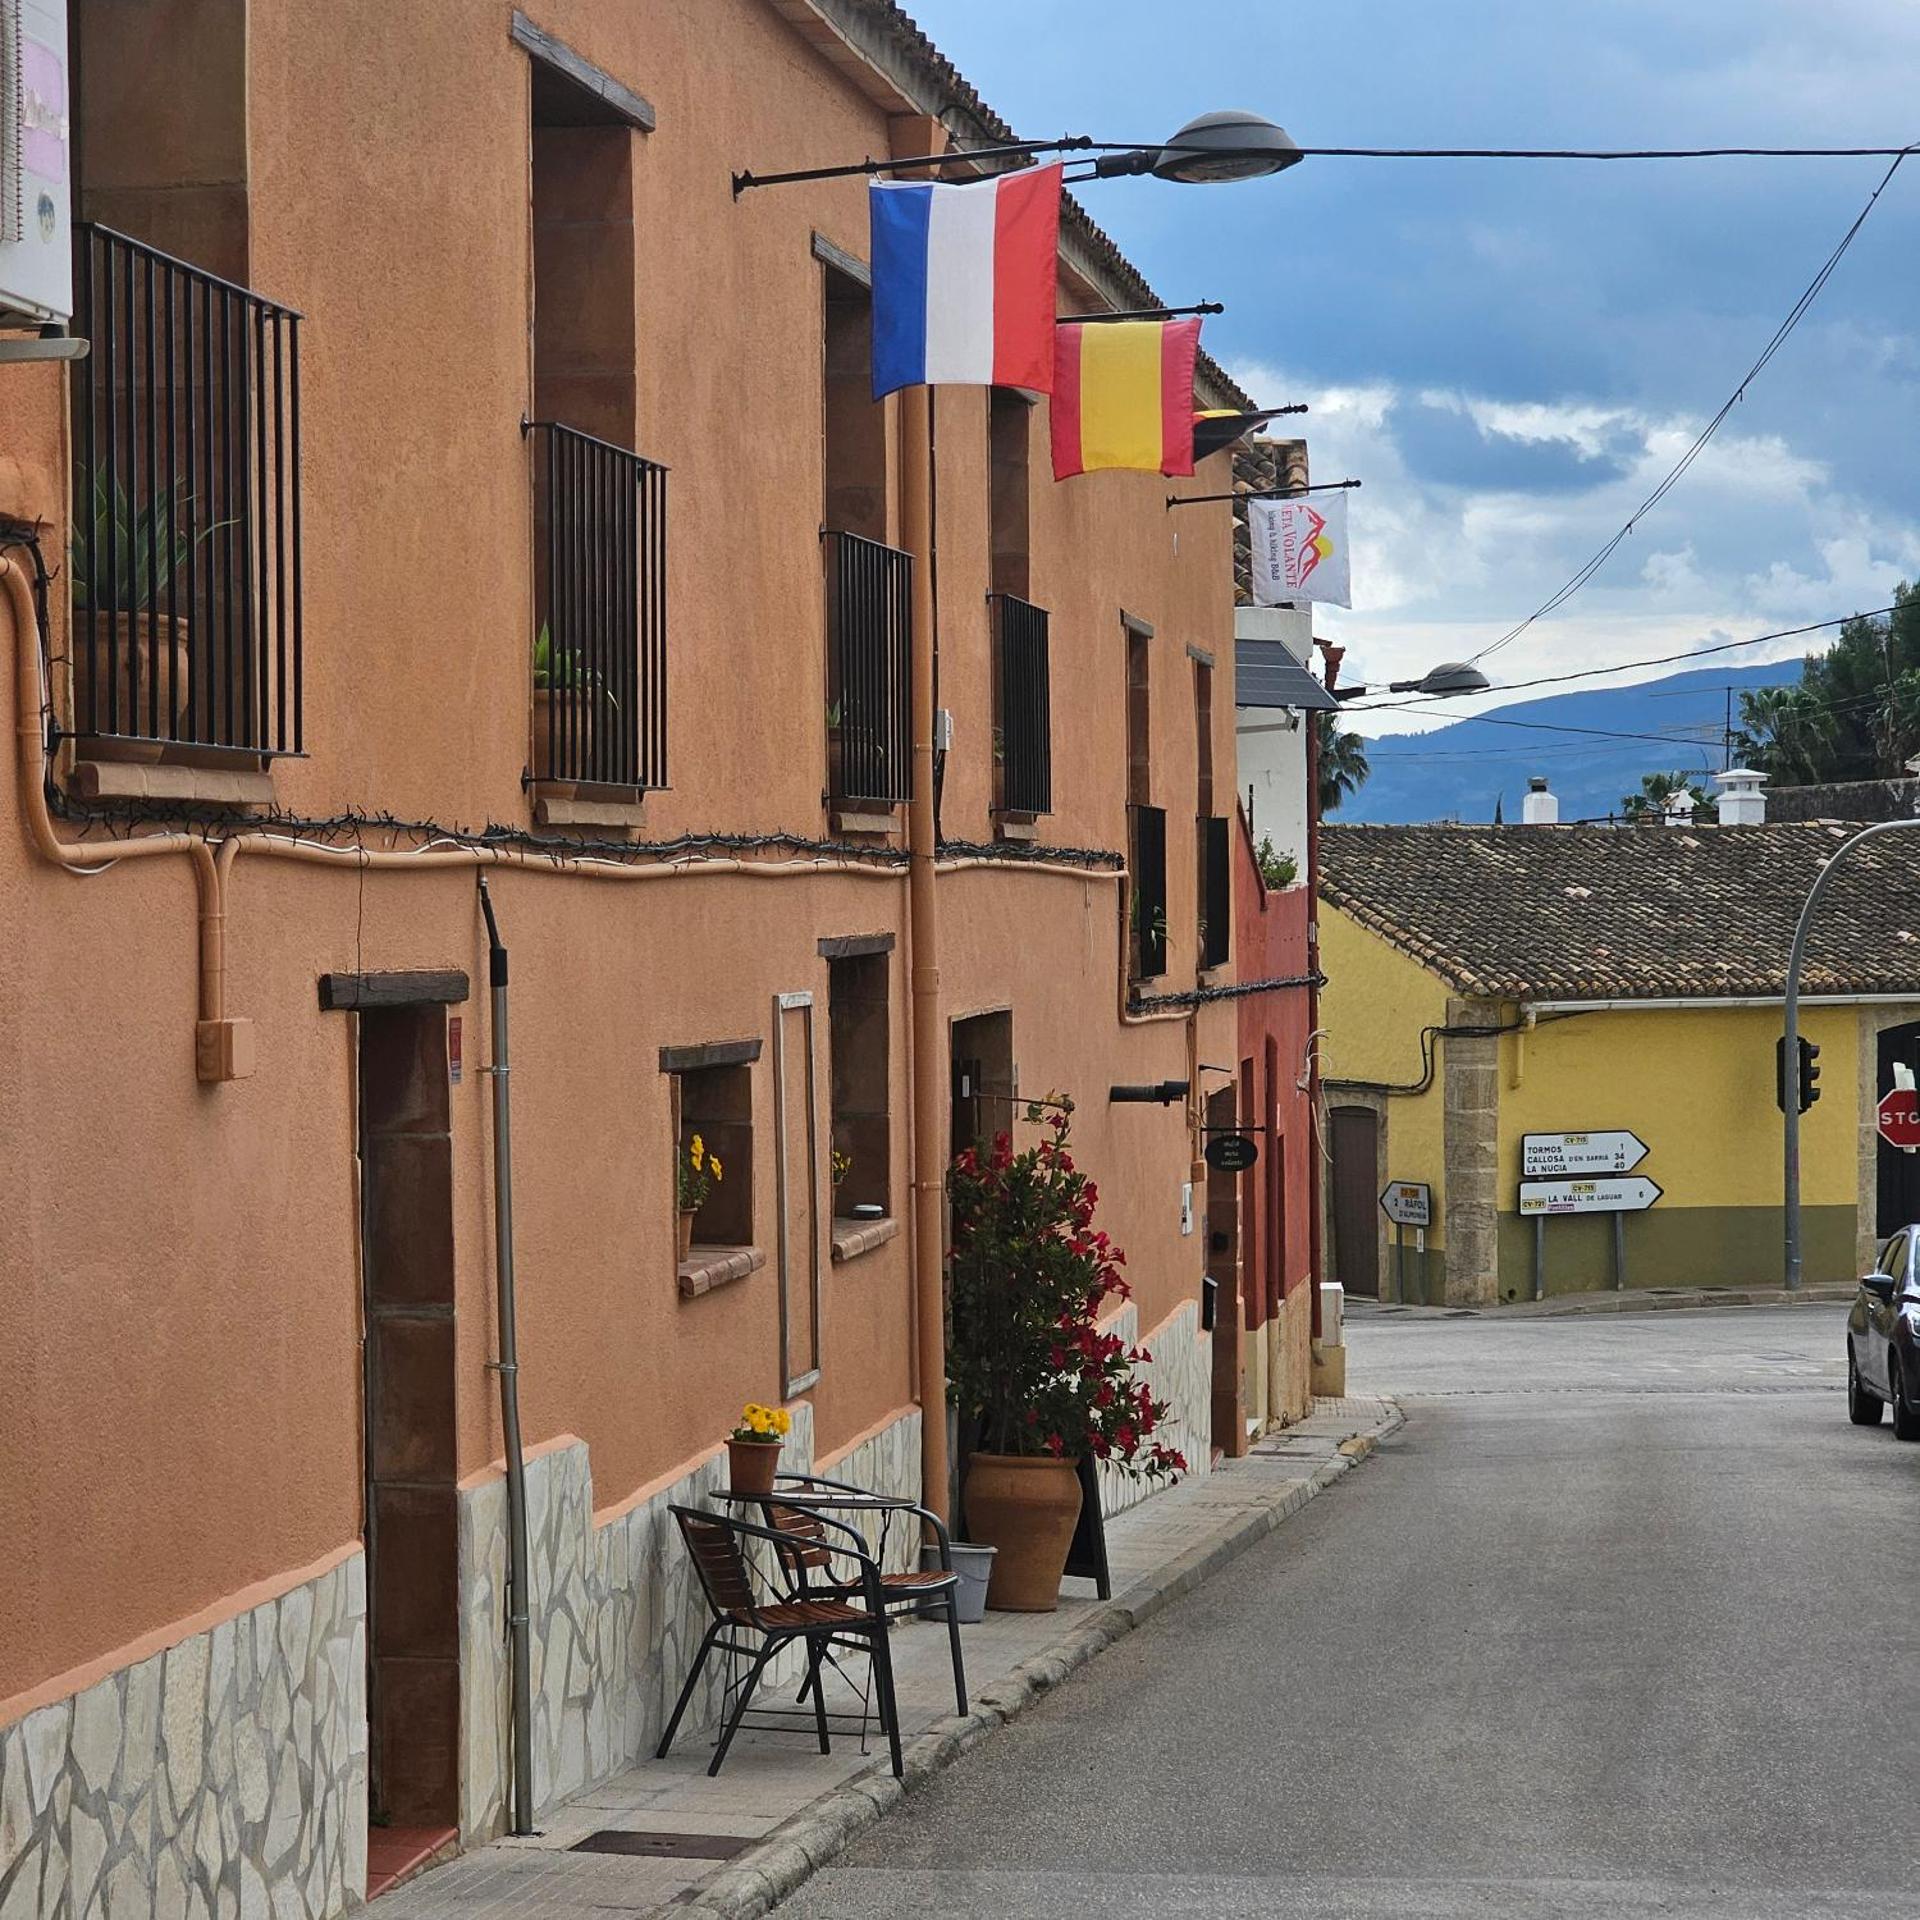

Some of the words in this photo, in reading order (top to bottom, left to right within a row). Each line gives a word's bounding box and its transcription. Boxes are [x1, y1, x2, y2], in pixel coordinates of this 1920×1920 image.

[1282, 531, 1298, 589] VOLANTE
[1271, 563, 1280, 581] B&B
[1527, 1146, 1562, 1154] TORMOS
[1527, 1155, 1565, 1163] CALLOSA
[1526, 1165, 1537, 1173] LA
[1541, 1164, 1567, 1172] NUCIA
[1548, 1195, 1558, 1203] LA
[1562, 1194, 1582, 1202] VALL
[1639, 1191, 1644, 1199] 6
